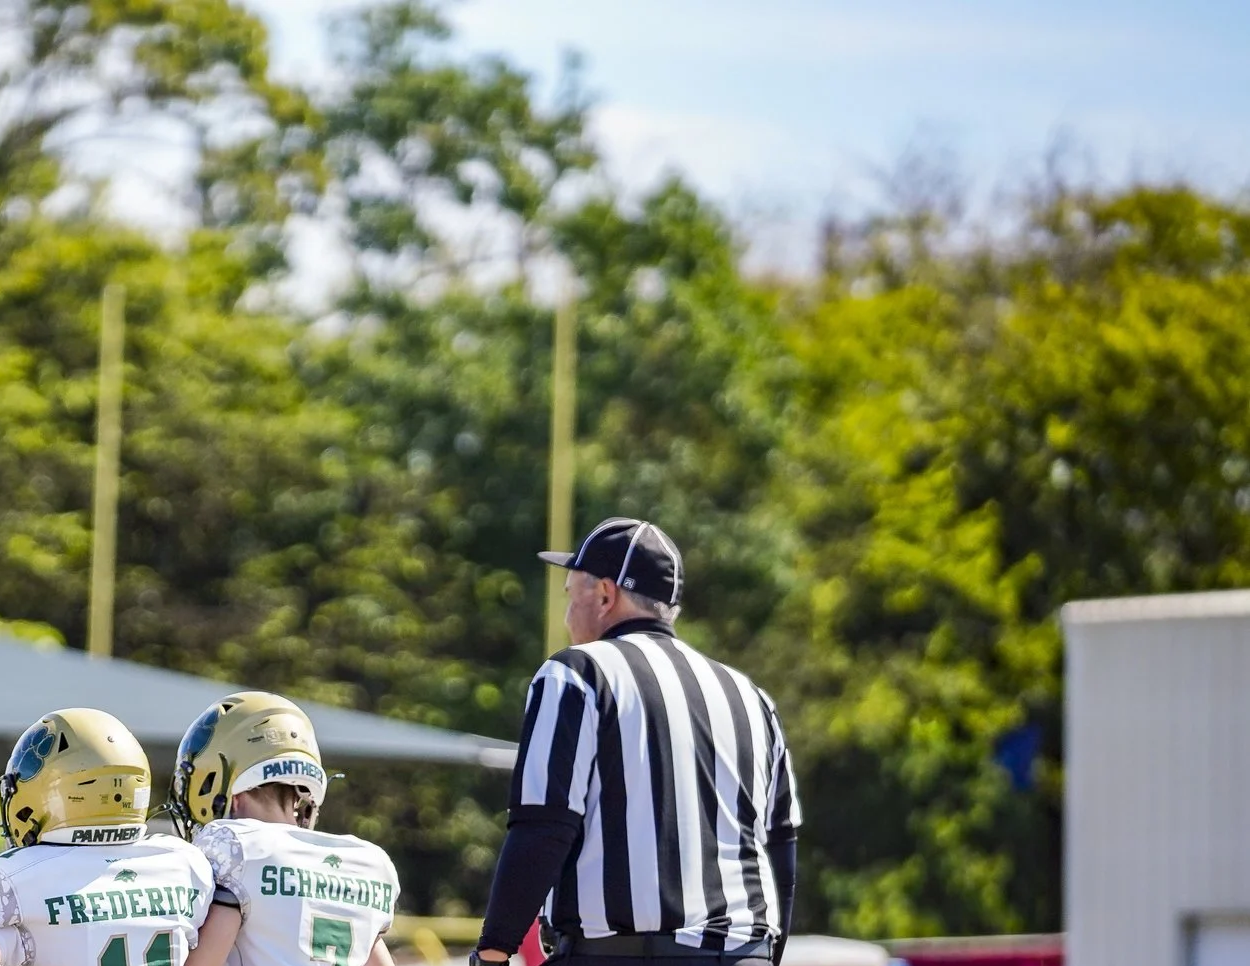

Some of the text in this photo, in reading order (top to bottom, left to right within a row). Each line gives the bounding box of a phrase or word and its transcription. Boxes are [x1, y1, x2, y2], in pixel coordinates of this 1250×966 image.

[114, 778, 122, 788] 11
[44, 885, 200, 925] FREDERICK
[260, 865, 393, 914] SCHROEDER
